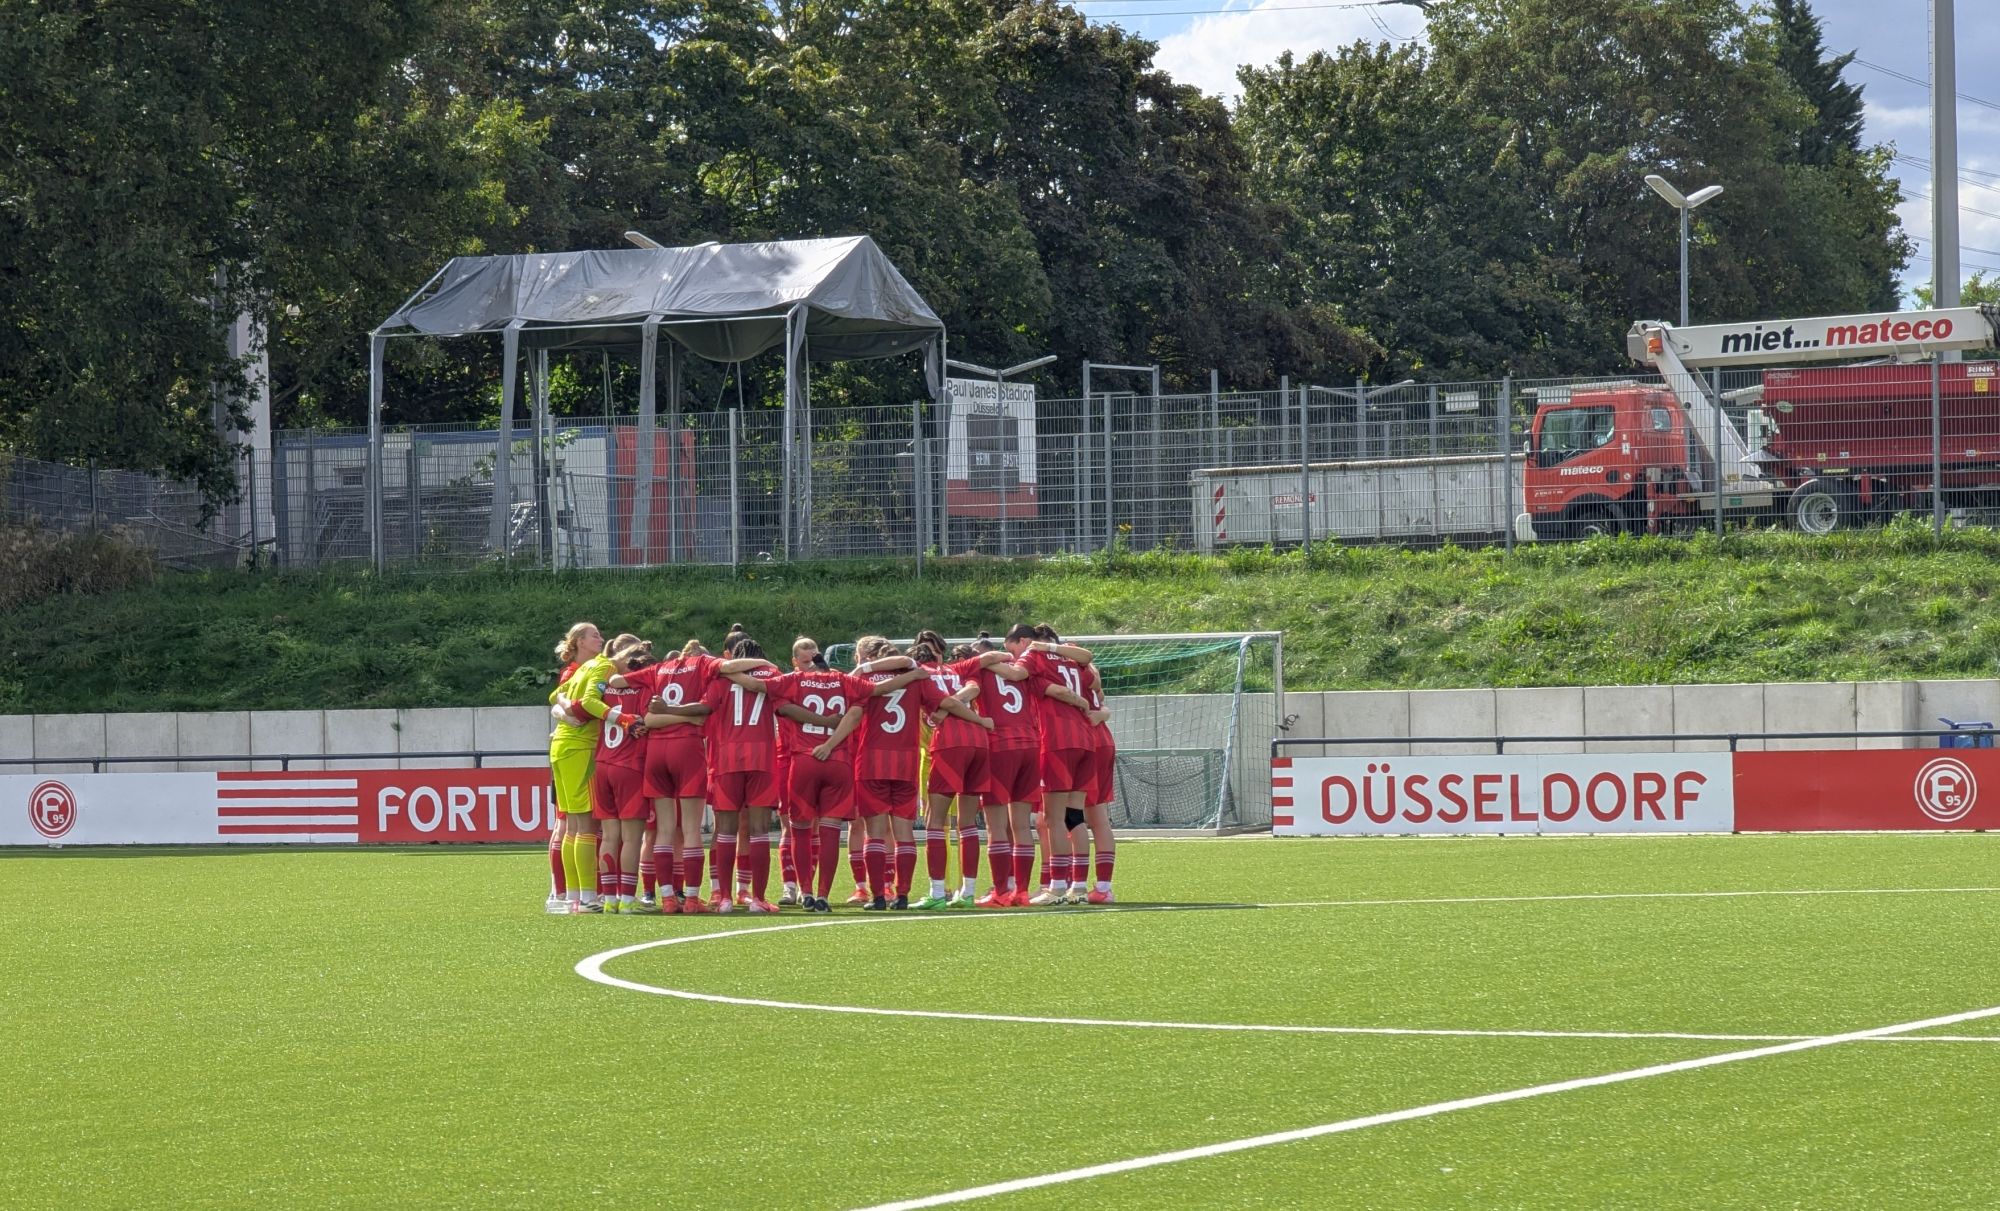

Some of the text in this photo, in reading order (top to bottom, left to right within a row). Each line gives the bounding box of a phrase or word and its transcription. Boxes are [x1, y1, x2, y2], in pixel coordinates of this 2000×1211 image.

[1721, 317, 1953, 353] miet... mateco
[947, 380, 967, 398] Paul
[1001, 384, 1034, 402] Stadion
[1560, 465, 1603, 476] mateco
[730, 683, 766, 726] 17
[880, 688, 907, 734] 3
[995, 674, 1023, 714] 5
[1321, 763, 1708, 825] DÜSSELDORF
[1945, 795, 1961, 806] 95
[52, 814, 65, 824] 95
